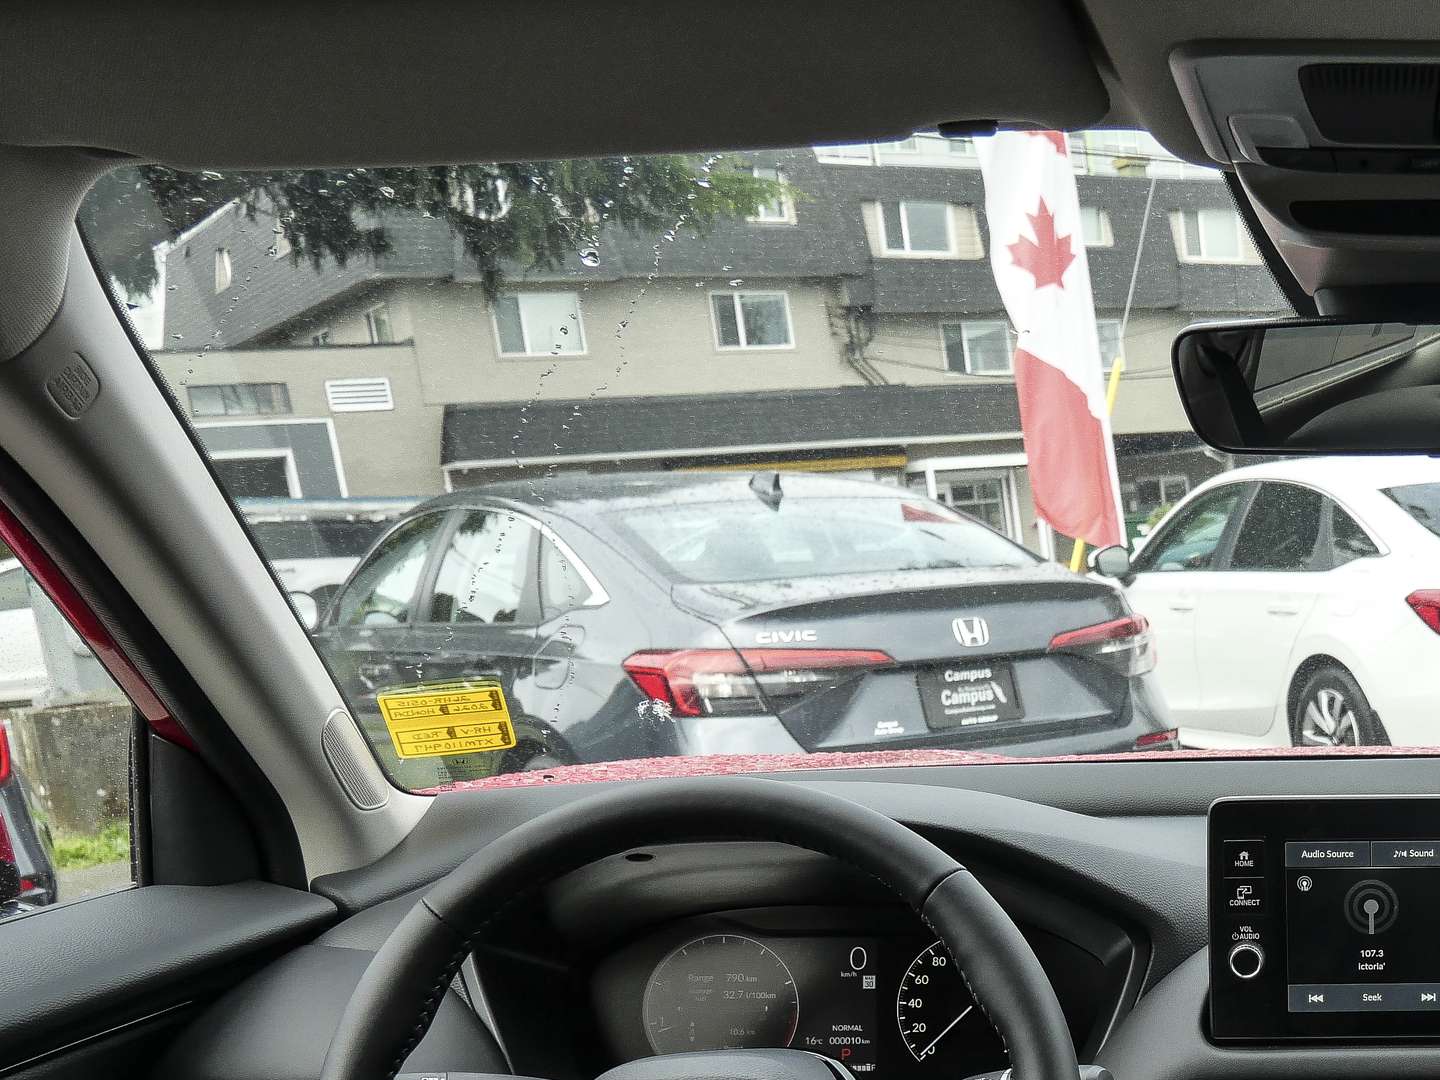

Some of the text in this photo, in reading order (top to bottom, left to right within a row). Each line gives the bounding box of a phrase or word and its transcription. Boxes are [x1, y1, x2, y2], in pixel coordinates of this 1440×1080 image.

[756, 629, 817, 644] CIVIC
[944, 668, 992, 682] Campus
[941, 687, 994, 706] Campus
[1301, 849, 1354, 859] Audio Source
[1409, 848, 1434, 859] Sound
[1234, 860, 1254, 868] HOME
[1229, 899, 1260, 907] CONNECT
[1239, 925, 1253, 933] VOL
[1239, 932, 1260, 940] AUDIO
[850, 946, 867, 971] 0
[1360, 949, 1385, 958] 107.3
[932, 956, 947, 967] 80
[726, 973, 745, 983] 790
[914, 975, 929, 985] 60
[723, 990, 744, 1000] 32.7
[1362, 993, 1383, 1002] Seek
[908, 998, 923, 1009] 40
[832, 1024, 863, 1032] NORMAL
[912, 1023, 927, 1033] 20
[841, 1048, 852, 1060] P
